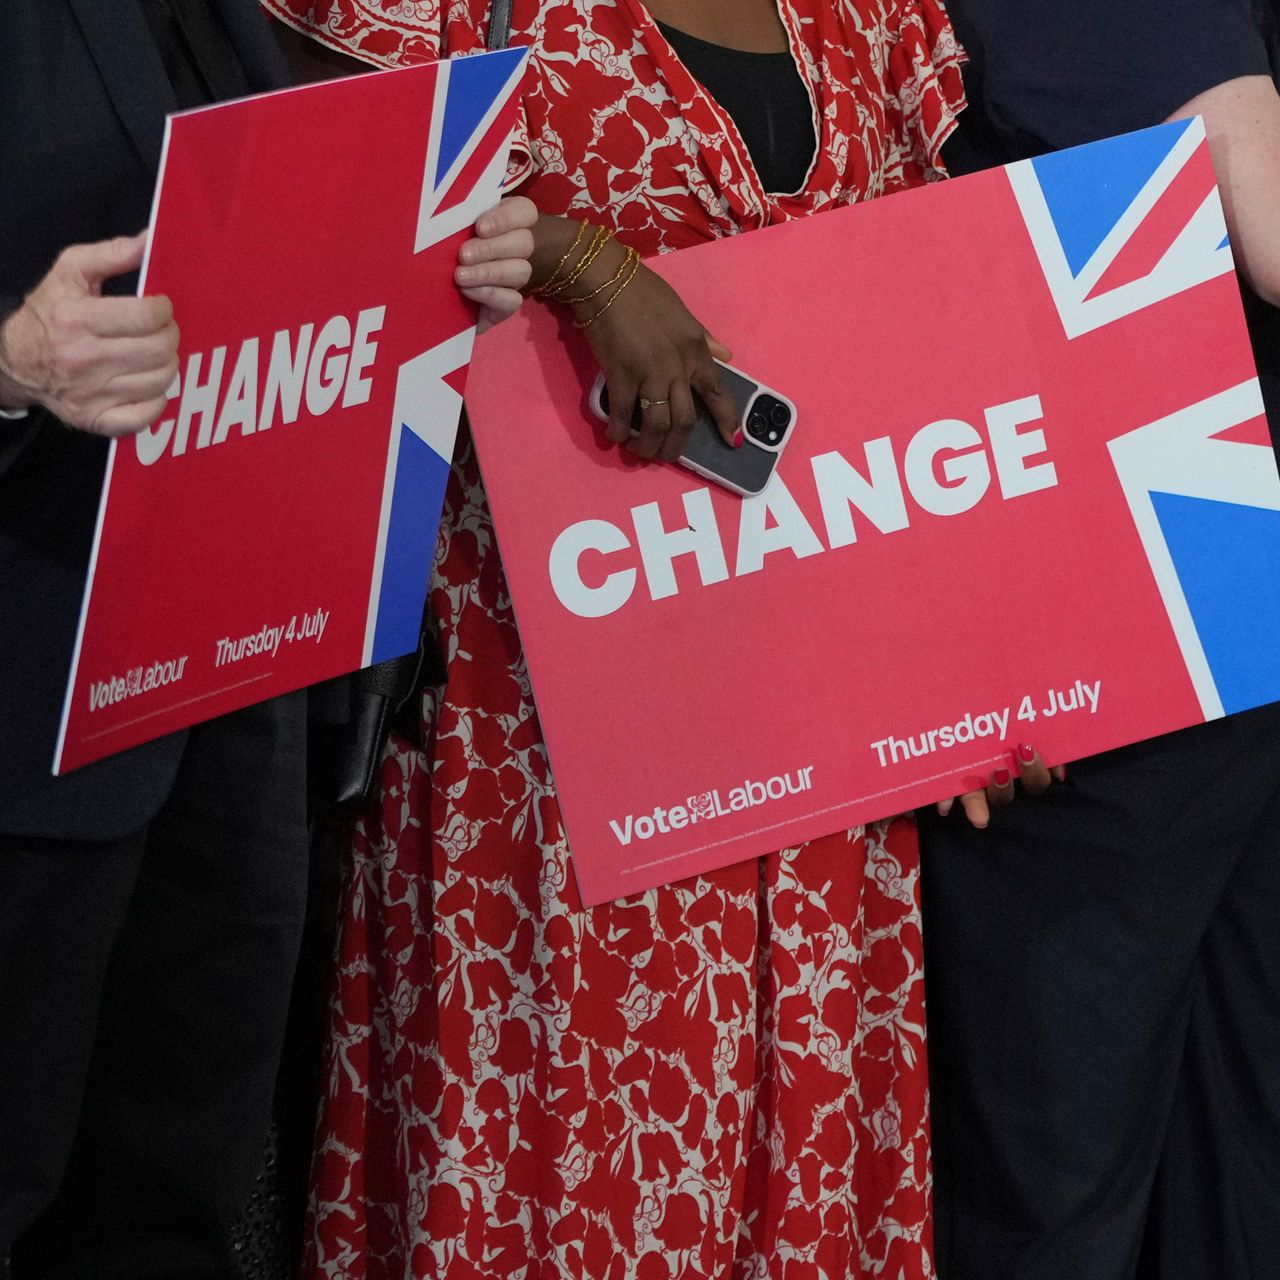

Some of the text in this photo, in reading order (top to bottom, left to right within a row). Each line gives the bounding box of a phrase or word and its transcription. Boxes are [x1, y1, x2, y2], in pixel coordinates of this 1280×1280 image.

[547, 393, 1058, 619] CHANGE
[215, 607, 330, 667] Thursday 4 July
[89, 674, 126, 712] Vote
[135, 655, 189, 695] Labour
[870, 679, 1101, 768] Thursday 4 July
[609, 765, 814, 846] Vote Labour
